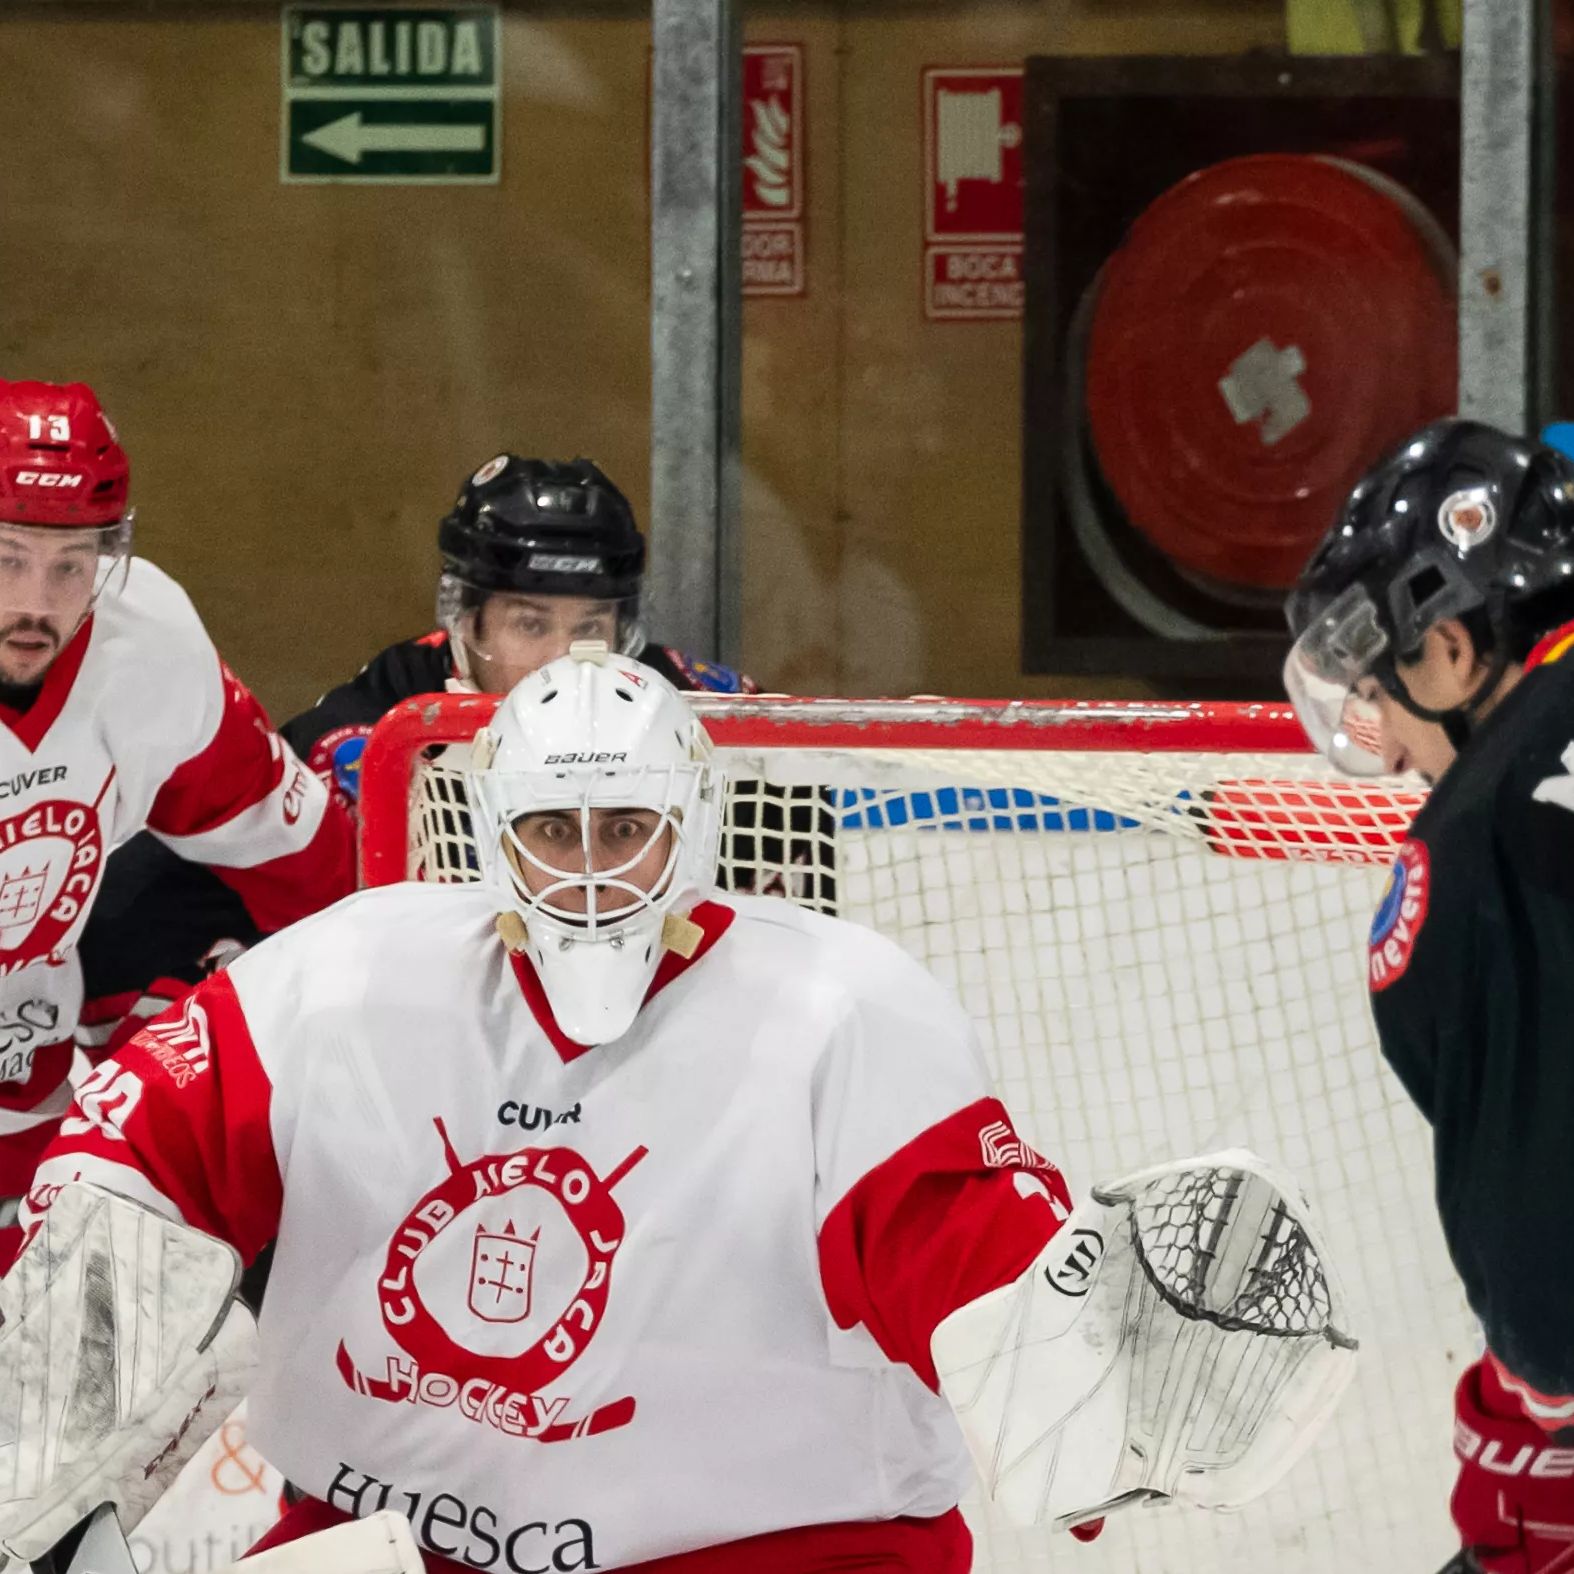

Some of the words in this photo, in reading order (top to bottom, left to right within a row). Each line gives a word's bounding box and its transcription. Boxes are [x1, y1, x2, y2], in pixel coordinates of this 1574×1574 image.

[301, 20, 482, 75] SALIDA
[948, 253, 1019, 278] BOCA
[28, 414, 70, 441] 13
[15, 470, 84, 488] CCM
[544, 751, 627, 765] BAUER
[381, 1199, 455, 1326] CLUB
[386, 1355, 572, 1438] HOCKEY
